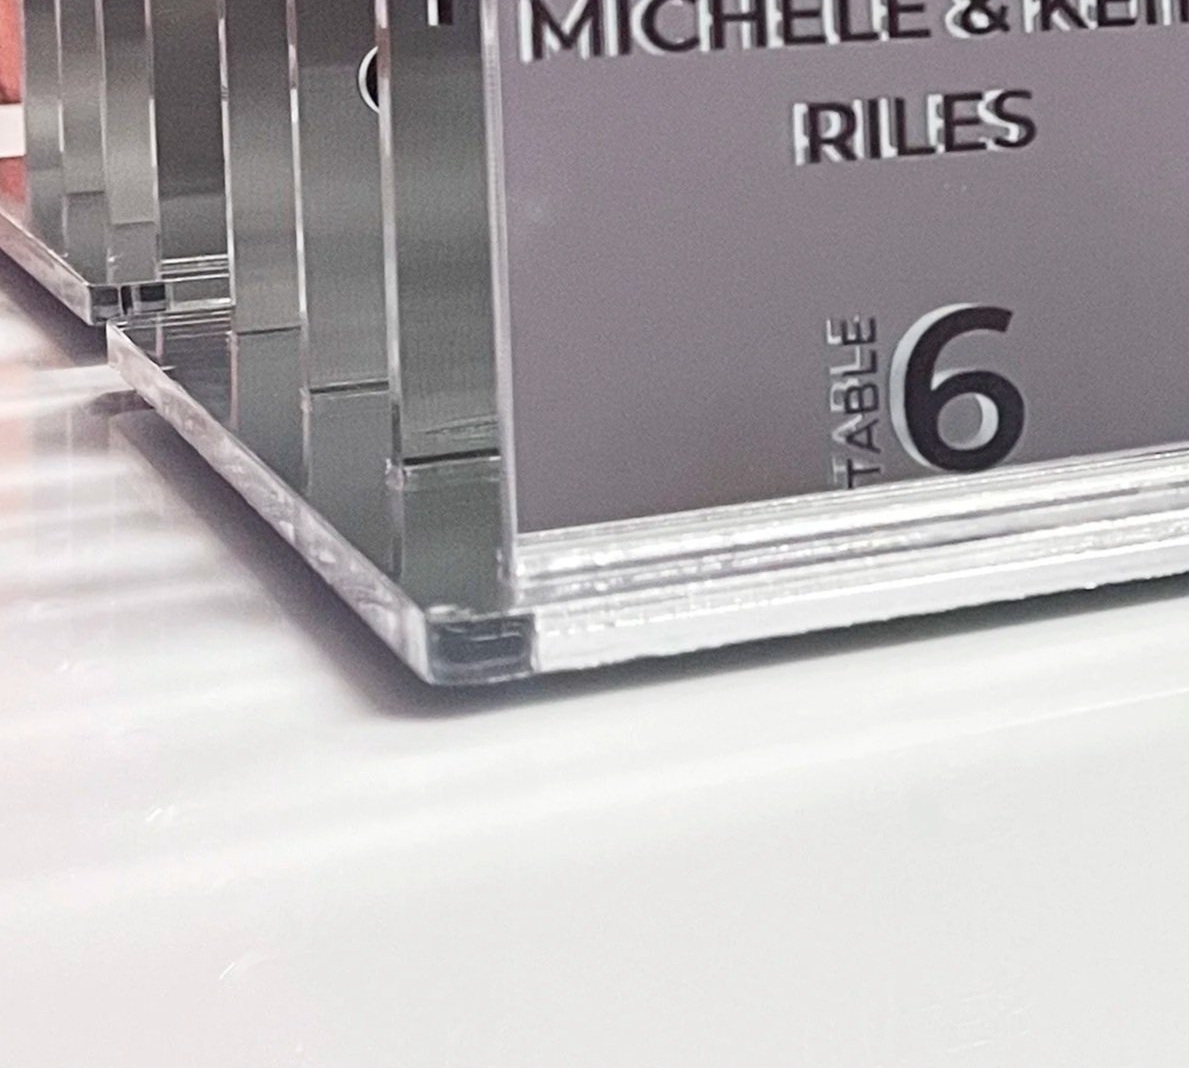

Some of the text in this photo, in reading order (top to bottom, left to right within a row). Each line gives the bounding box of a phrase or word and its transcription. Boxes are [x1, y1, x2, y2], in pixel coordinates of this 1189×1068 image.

[798, 89, 1038, 164] RILES
[834, 315, 881, 490] TABLE
[896, 304, 1026, 473] 6
